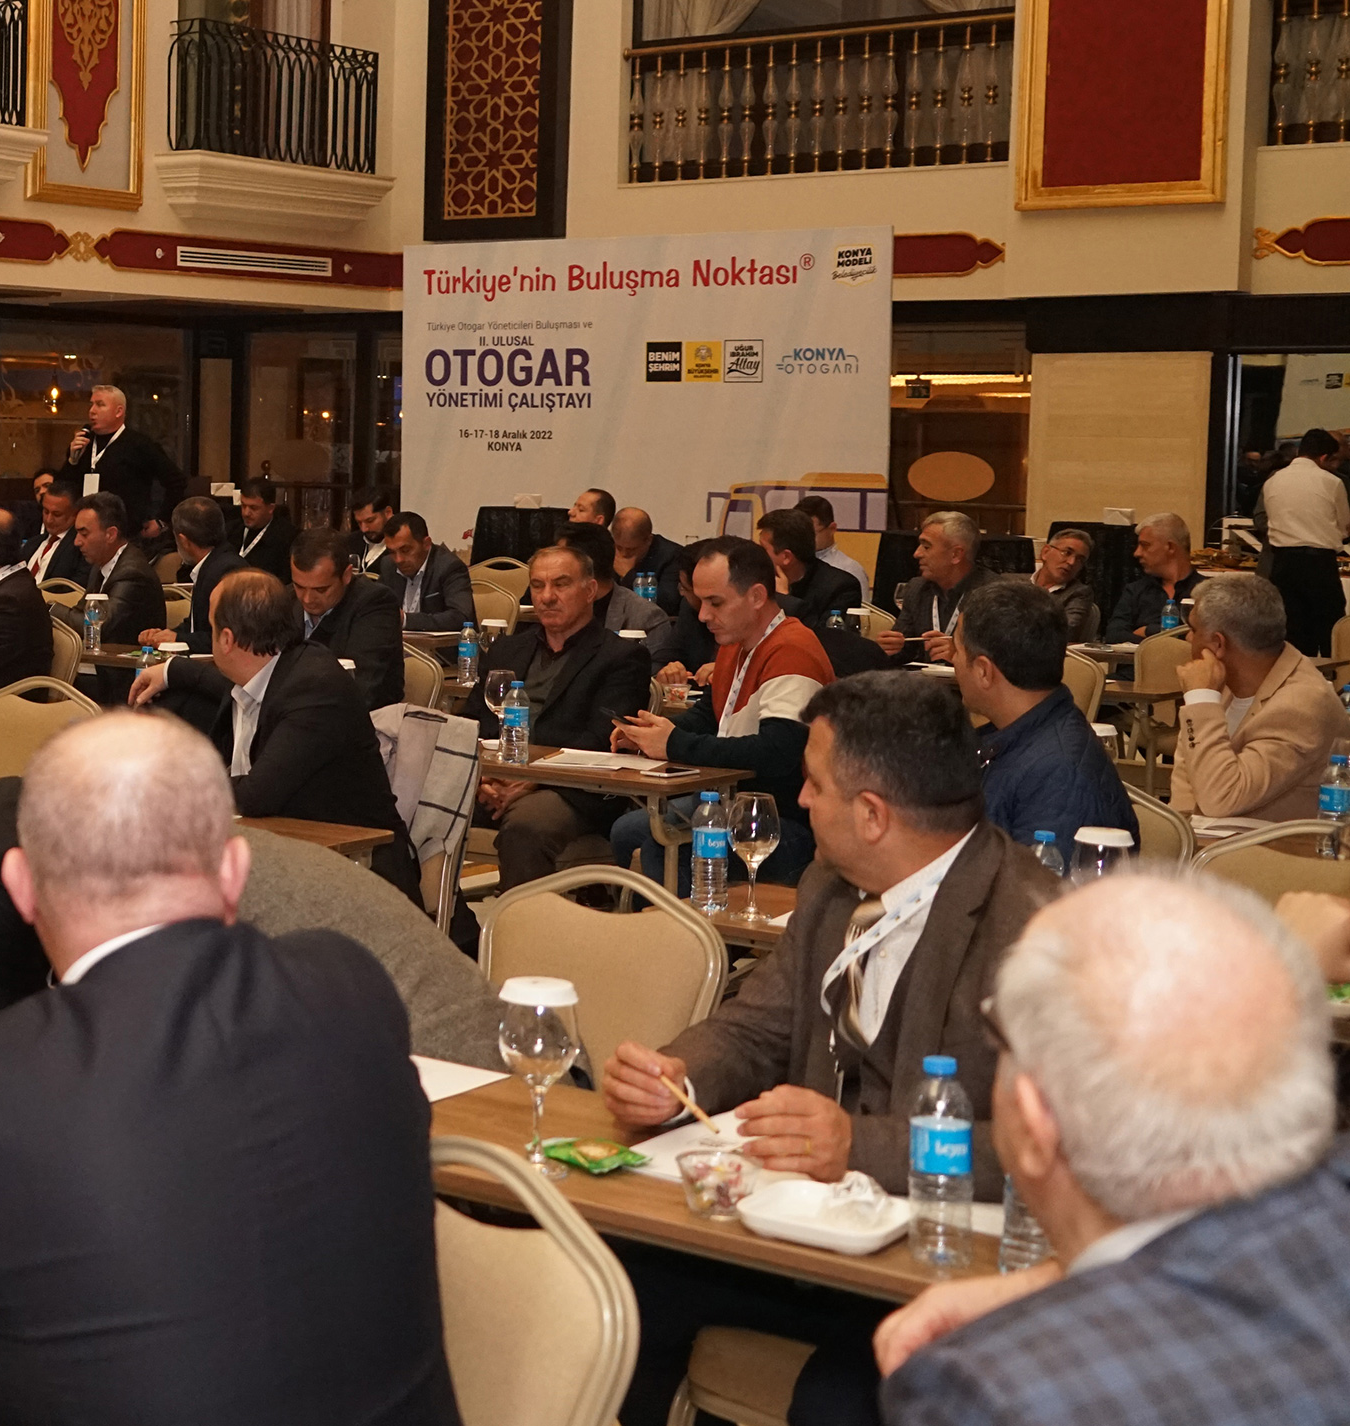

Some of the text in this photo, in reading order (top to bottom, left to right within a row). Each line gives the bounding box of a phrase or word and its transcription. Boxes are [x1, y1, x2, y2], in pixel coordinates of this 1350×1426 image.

[838, 247, 872, 259] KONYA
[423, 266, 556, 302] Türkiye'nin
[568, 261, 679, 296] Buluşma
[427, 320, 593, 333] Türkiye Otogar Yöneticileri Buluşması ve
[479, 336, 535, 346] II. ULUSAL
[793, 348, 846, 361] KONYA
[425, 348, 591, 387] OTOGAR
[426, 389, 592, 413] YÖNETİMİ ÇALIŞTAYI
[459, 429, 553, 440] 16-17-18 Aralık 2022
[487, 442, 522, 451] KONYA
